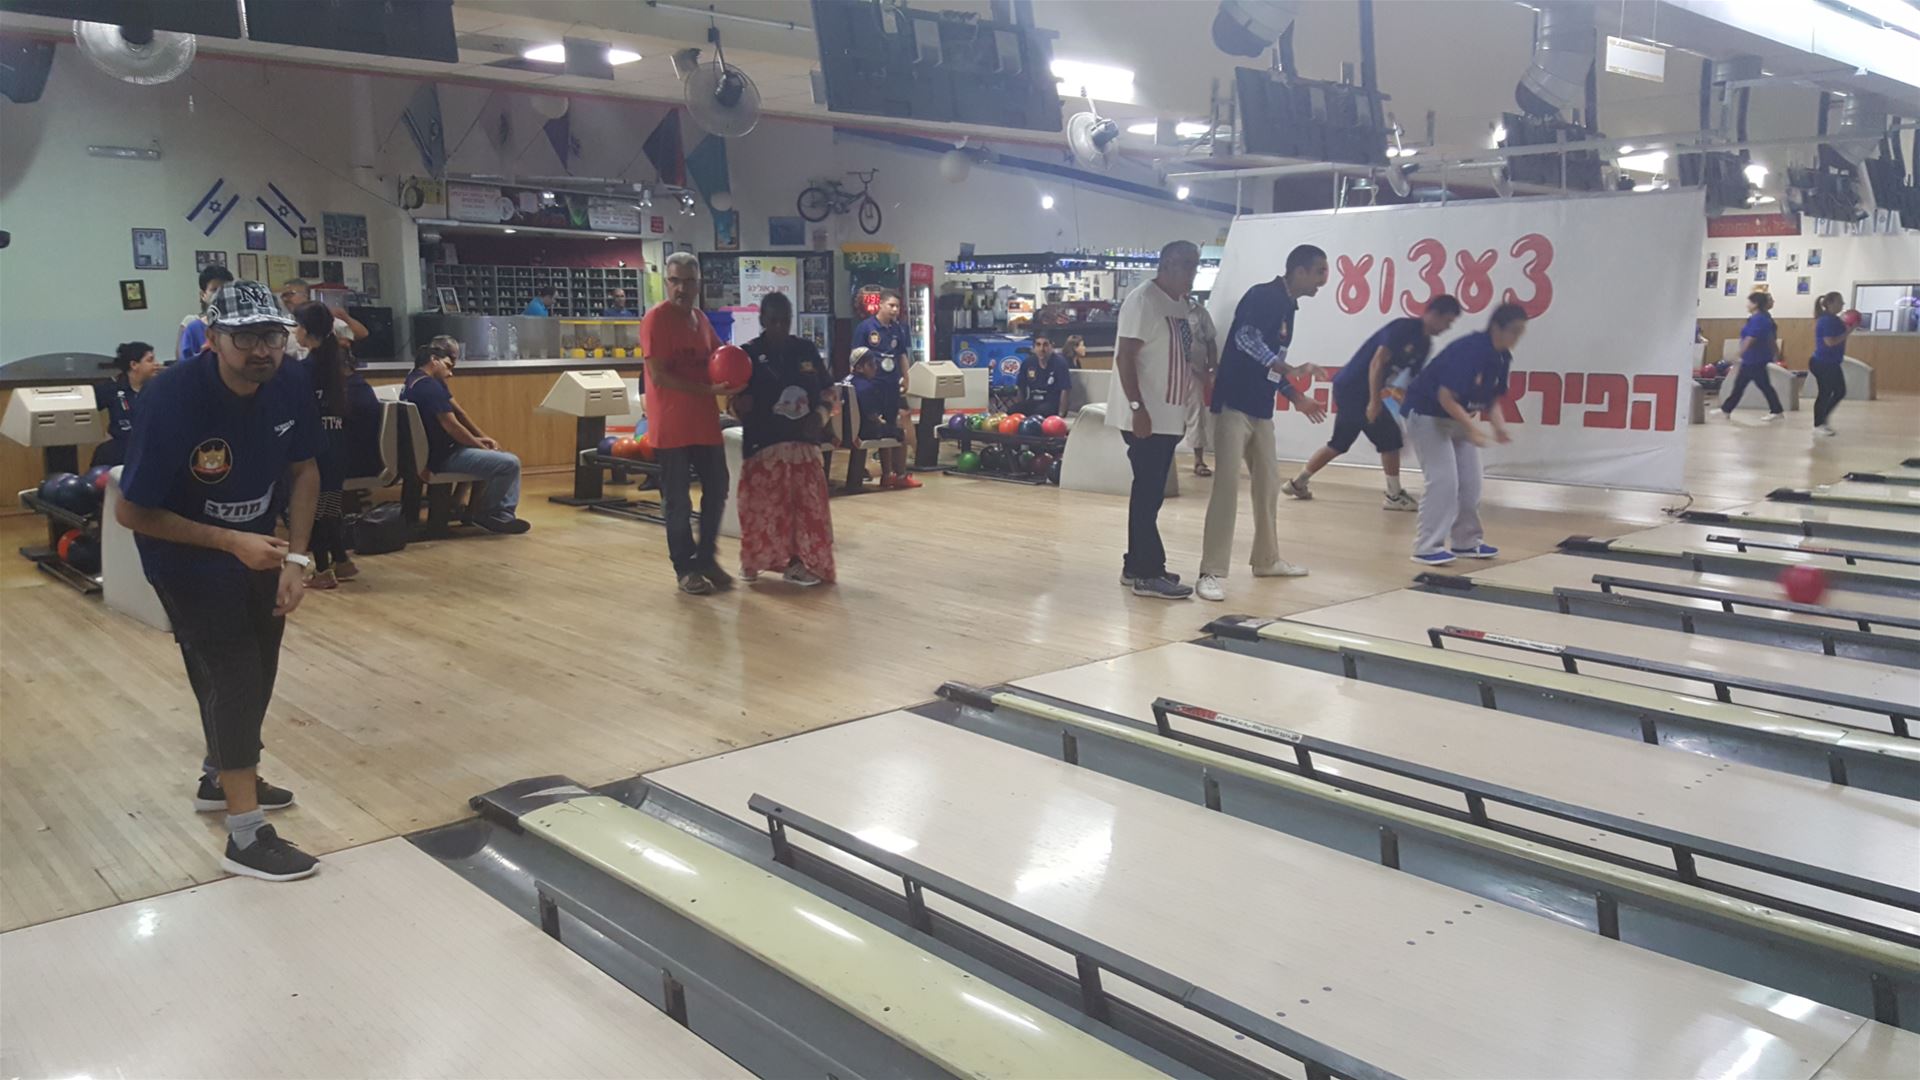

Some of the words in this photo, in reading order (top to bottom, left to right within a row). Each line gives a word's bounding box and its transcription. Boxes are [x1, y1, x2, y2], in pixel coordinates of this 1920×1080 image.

[236, 286, 269, 308] NY
[1479, 370, 1679, 432] הפירא
[207, 501, 262, 517] מחלב
